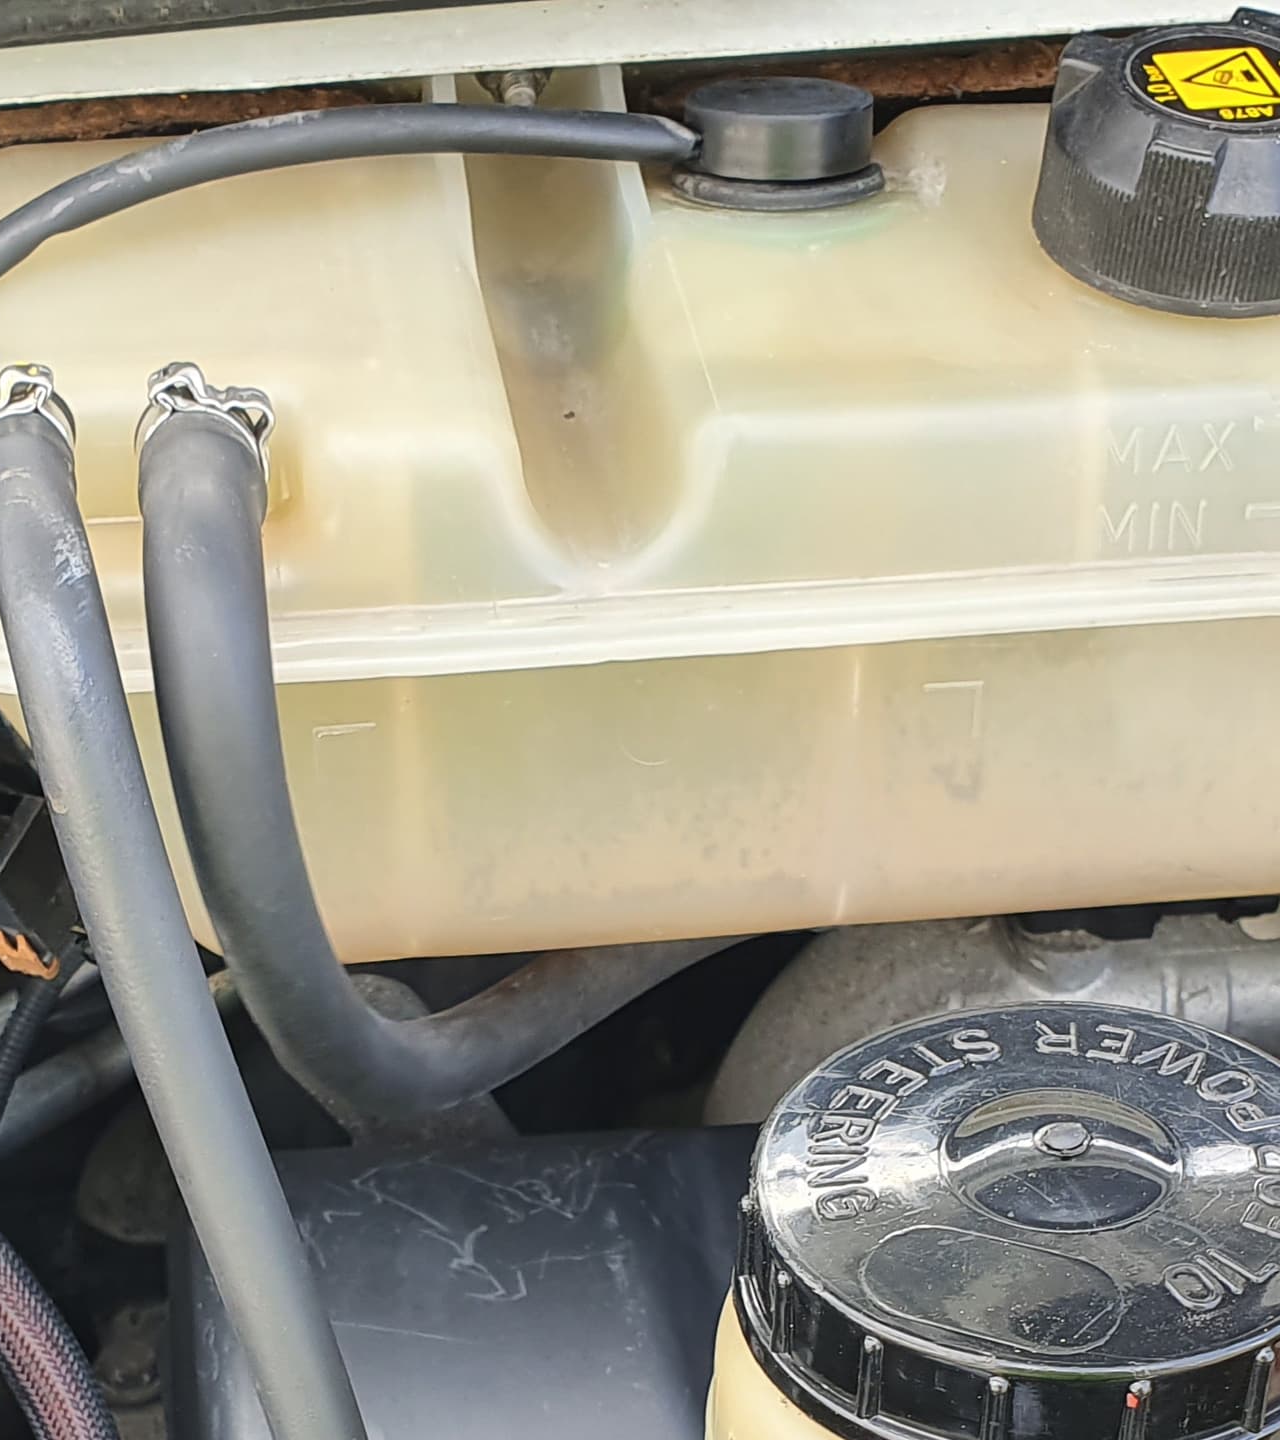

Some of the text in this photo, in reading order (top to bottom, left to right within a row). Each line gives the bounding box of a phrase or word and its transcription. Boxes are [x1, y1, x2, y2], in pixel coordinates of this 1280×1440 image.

[1106, 420, 1236, 474] MAX
[1096, 498, 1207, 551] MIN
[805, 1028, 1002, 1221] STEERING
[1163, 1248, 1280, 1311] OIL
